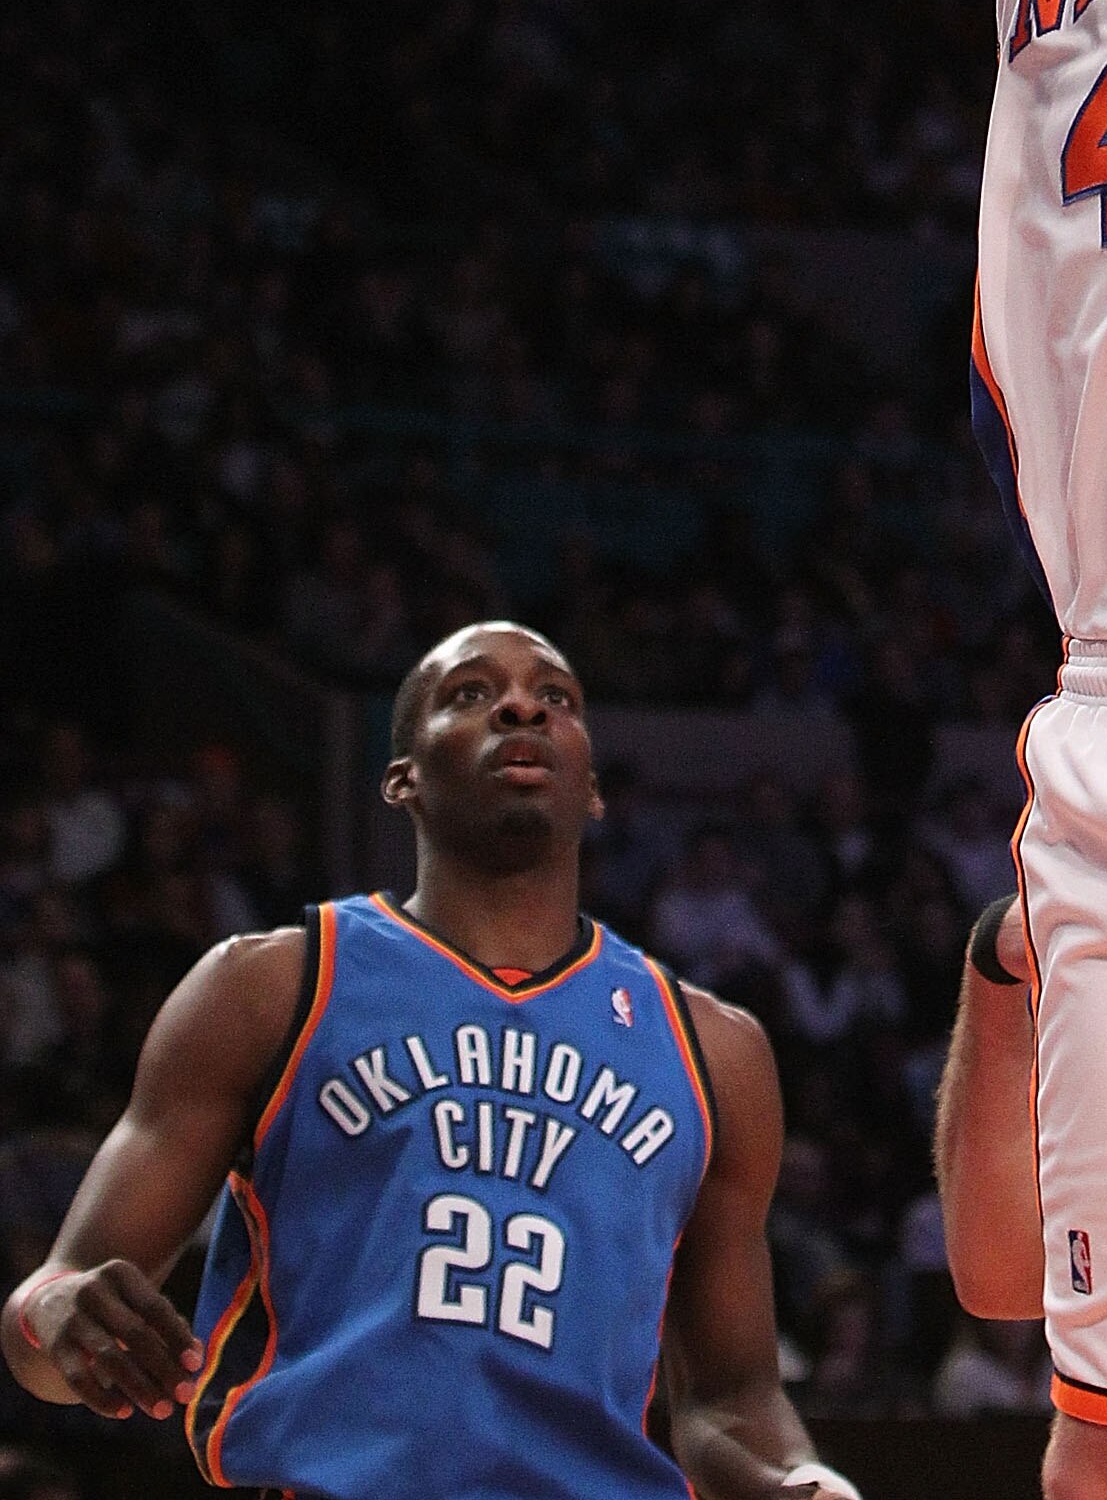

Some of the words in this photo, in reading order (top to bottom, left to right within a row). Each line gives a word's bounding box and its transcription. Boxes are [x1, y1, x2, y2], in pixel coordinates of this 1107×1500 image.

[318, 1024, 676, 1166] OKLAHOMA
[433, 1099, 577, 1190] CITY
[416, 1194, 566, 1350] 22
